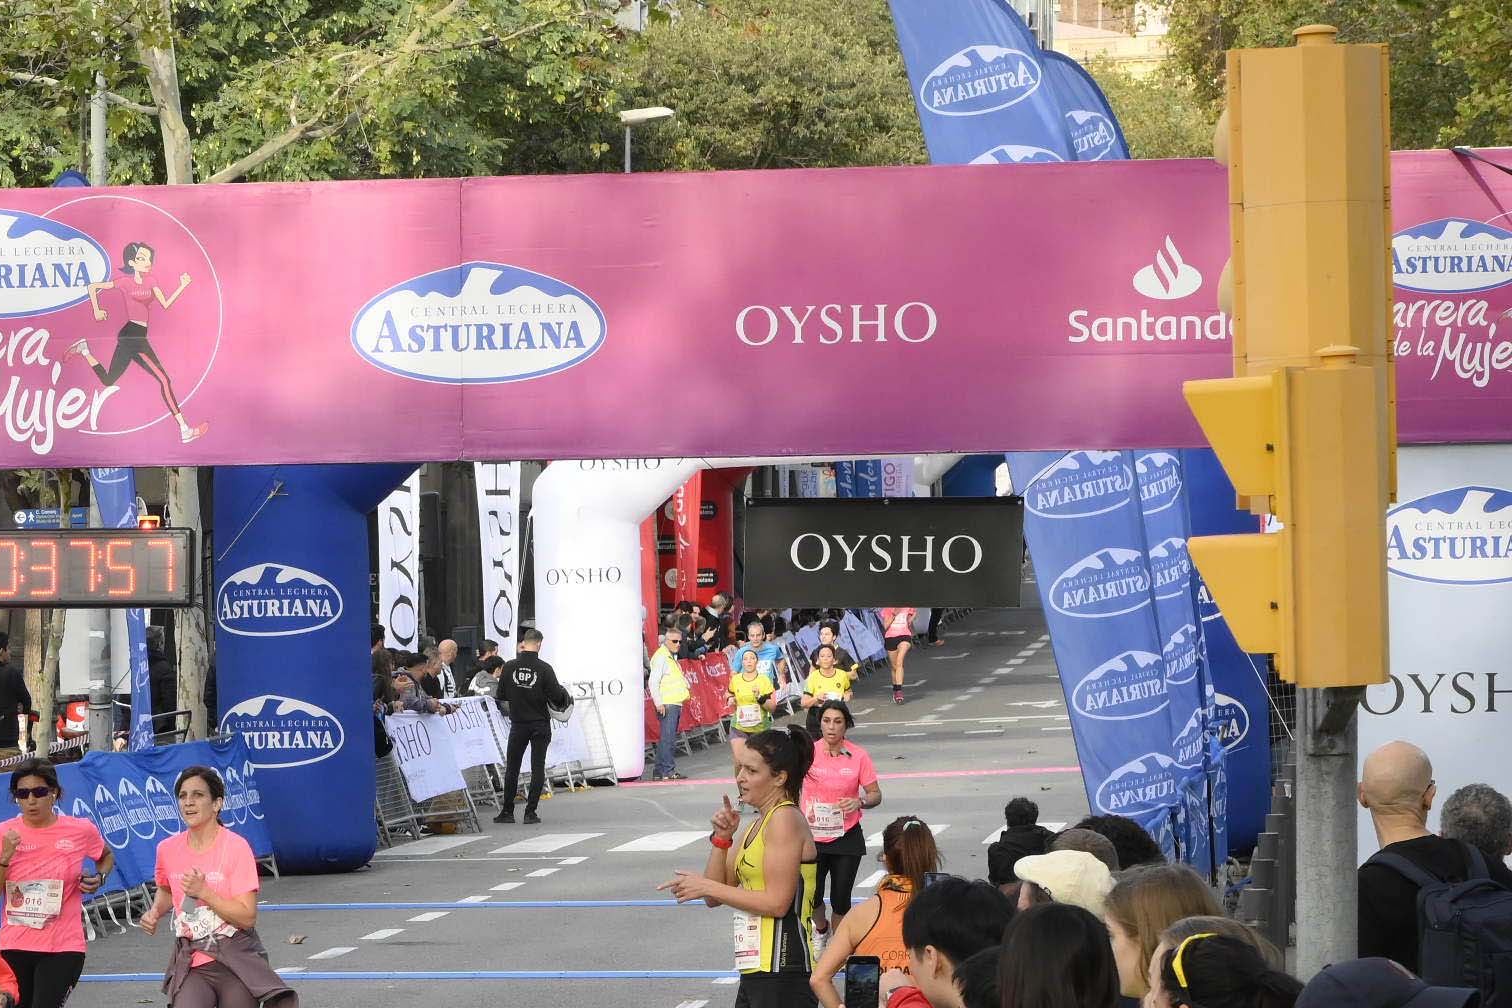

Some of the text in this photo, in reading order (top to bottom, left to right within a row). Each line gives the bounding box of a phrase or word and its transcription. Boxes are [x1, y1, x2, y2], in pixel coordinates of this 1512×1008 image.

[14, 245, 87, 258] LECHERA
[1407, 242, 1459, 253] CENTRAL
[410, 302, 578, 319] CENTRAL LECHERA
[1392, 299, 1489, 329] arrera
[371, 309, 587, 354] ASTURIANA
[735, 301, 938, 346] OYSHO
[1068, 309, 1234, 344] Santand
[1417, 328, 1436, 357] la
[1430, 322, 1512, 388] Muje
[1415, 520, 1483, 533] CENTRAL
[790, 532, 983, 574] OYSHO
[1386, 524, 1512, 561] ASTURI
[546, 565, 623, 586] OYSHO
[233, 588, 330, 596] CENTRAL LECHERA
[221, 593, 334, 620] ASTURIANA
[518, 671, 532, 681] BP
[1358, 671, 1512, 716] OYSH
[234, 719, 330, 729] CENTRAL LECHERA
[24, 896, 42, 905] 016
[734, 934, 744, 943] 16
